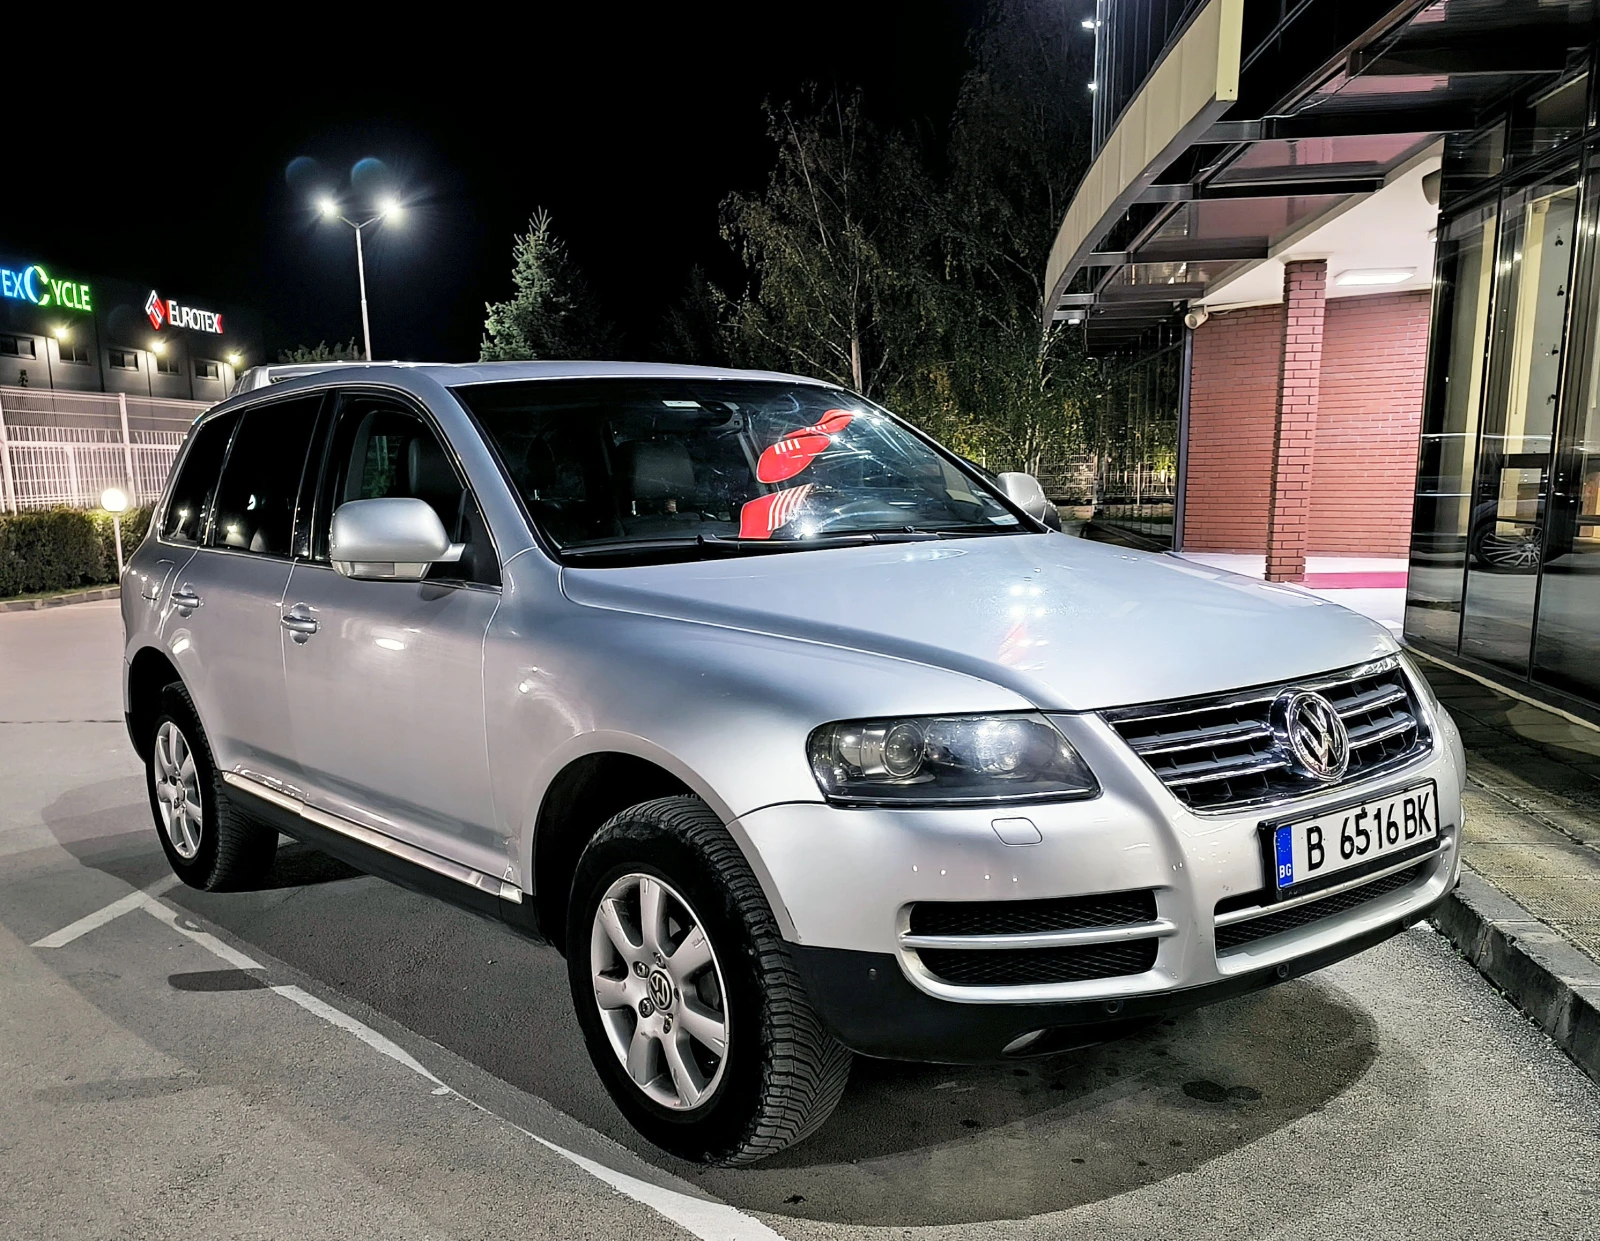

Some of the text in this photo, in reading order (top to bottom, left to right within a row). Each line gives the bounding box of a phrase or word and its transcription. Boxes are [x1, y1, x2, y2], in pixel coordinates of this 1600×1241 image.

[0, 265, 92, 312] EXCYCLE
[166, 299, 223, 333] EUROTEX
[1290, 697, 1347, 777] VW
[1306, 825, 1325, 872] B
[1279, 863, 1292, 879] BG
[649, 971, 671, 1008] VW
